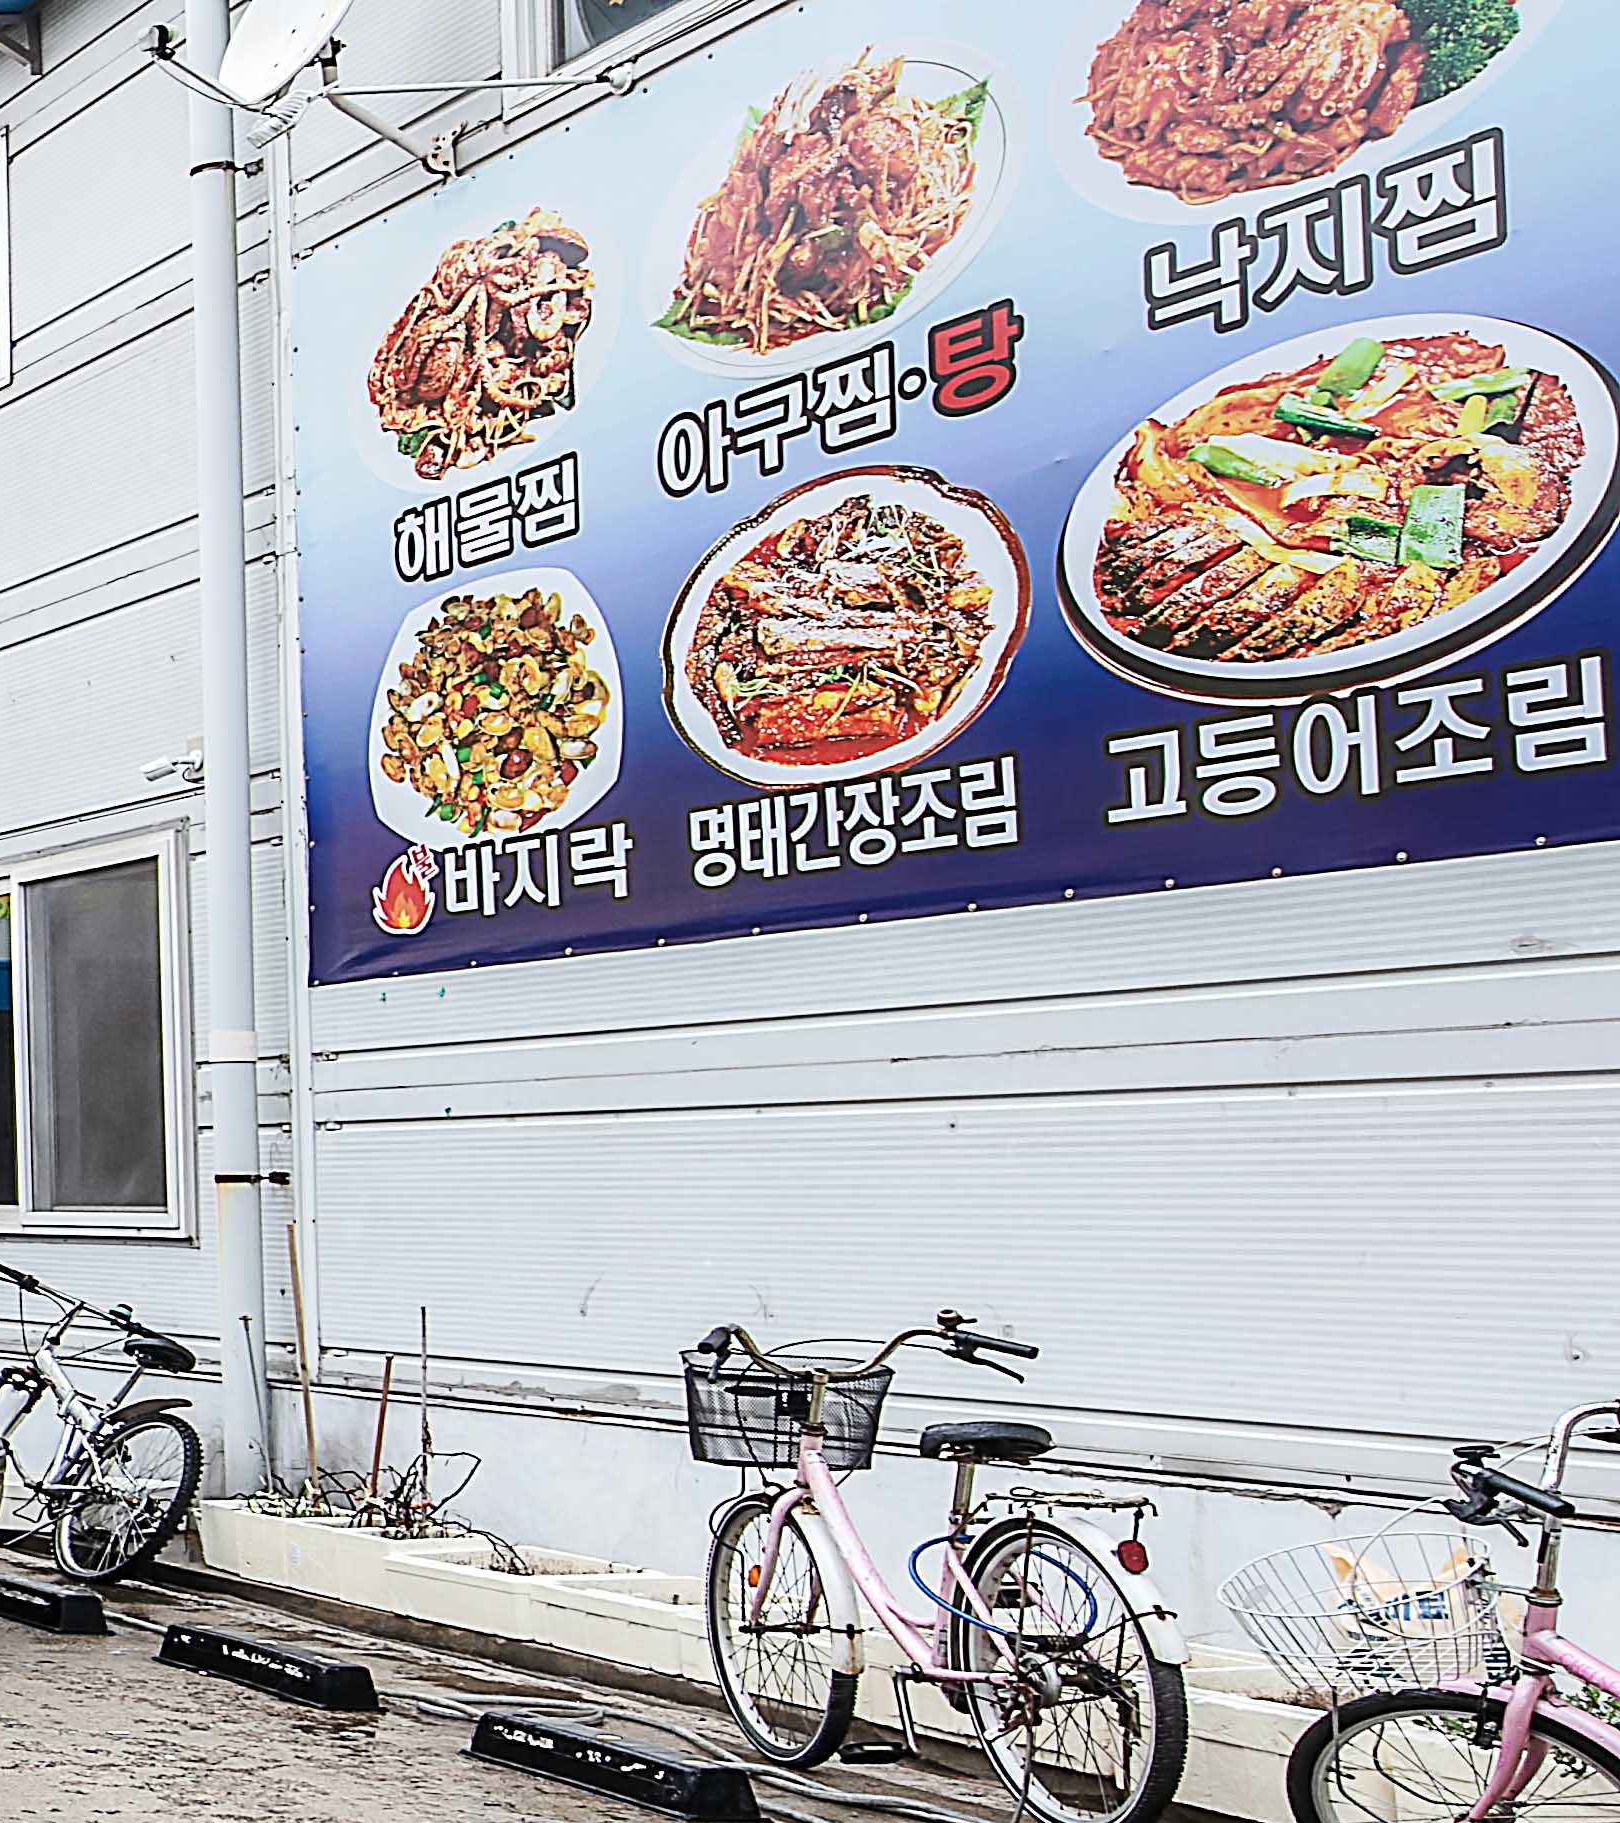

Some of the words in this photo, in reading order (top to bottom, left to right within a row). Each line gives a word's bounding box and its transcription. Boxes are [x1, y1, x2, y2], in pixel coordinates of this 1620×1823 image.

[1143, 127, 1507, 334] 낙지찜
[394, 453, 582, 582] 해물찜
[1100, 656, 1611, 828] 고등어조림
[443, 825, 630, 917] 바지락
[687, 755, 1020, 887] 명태간장조림
